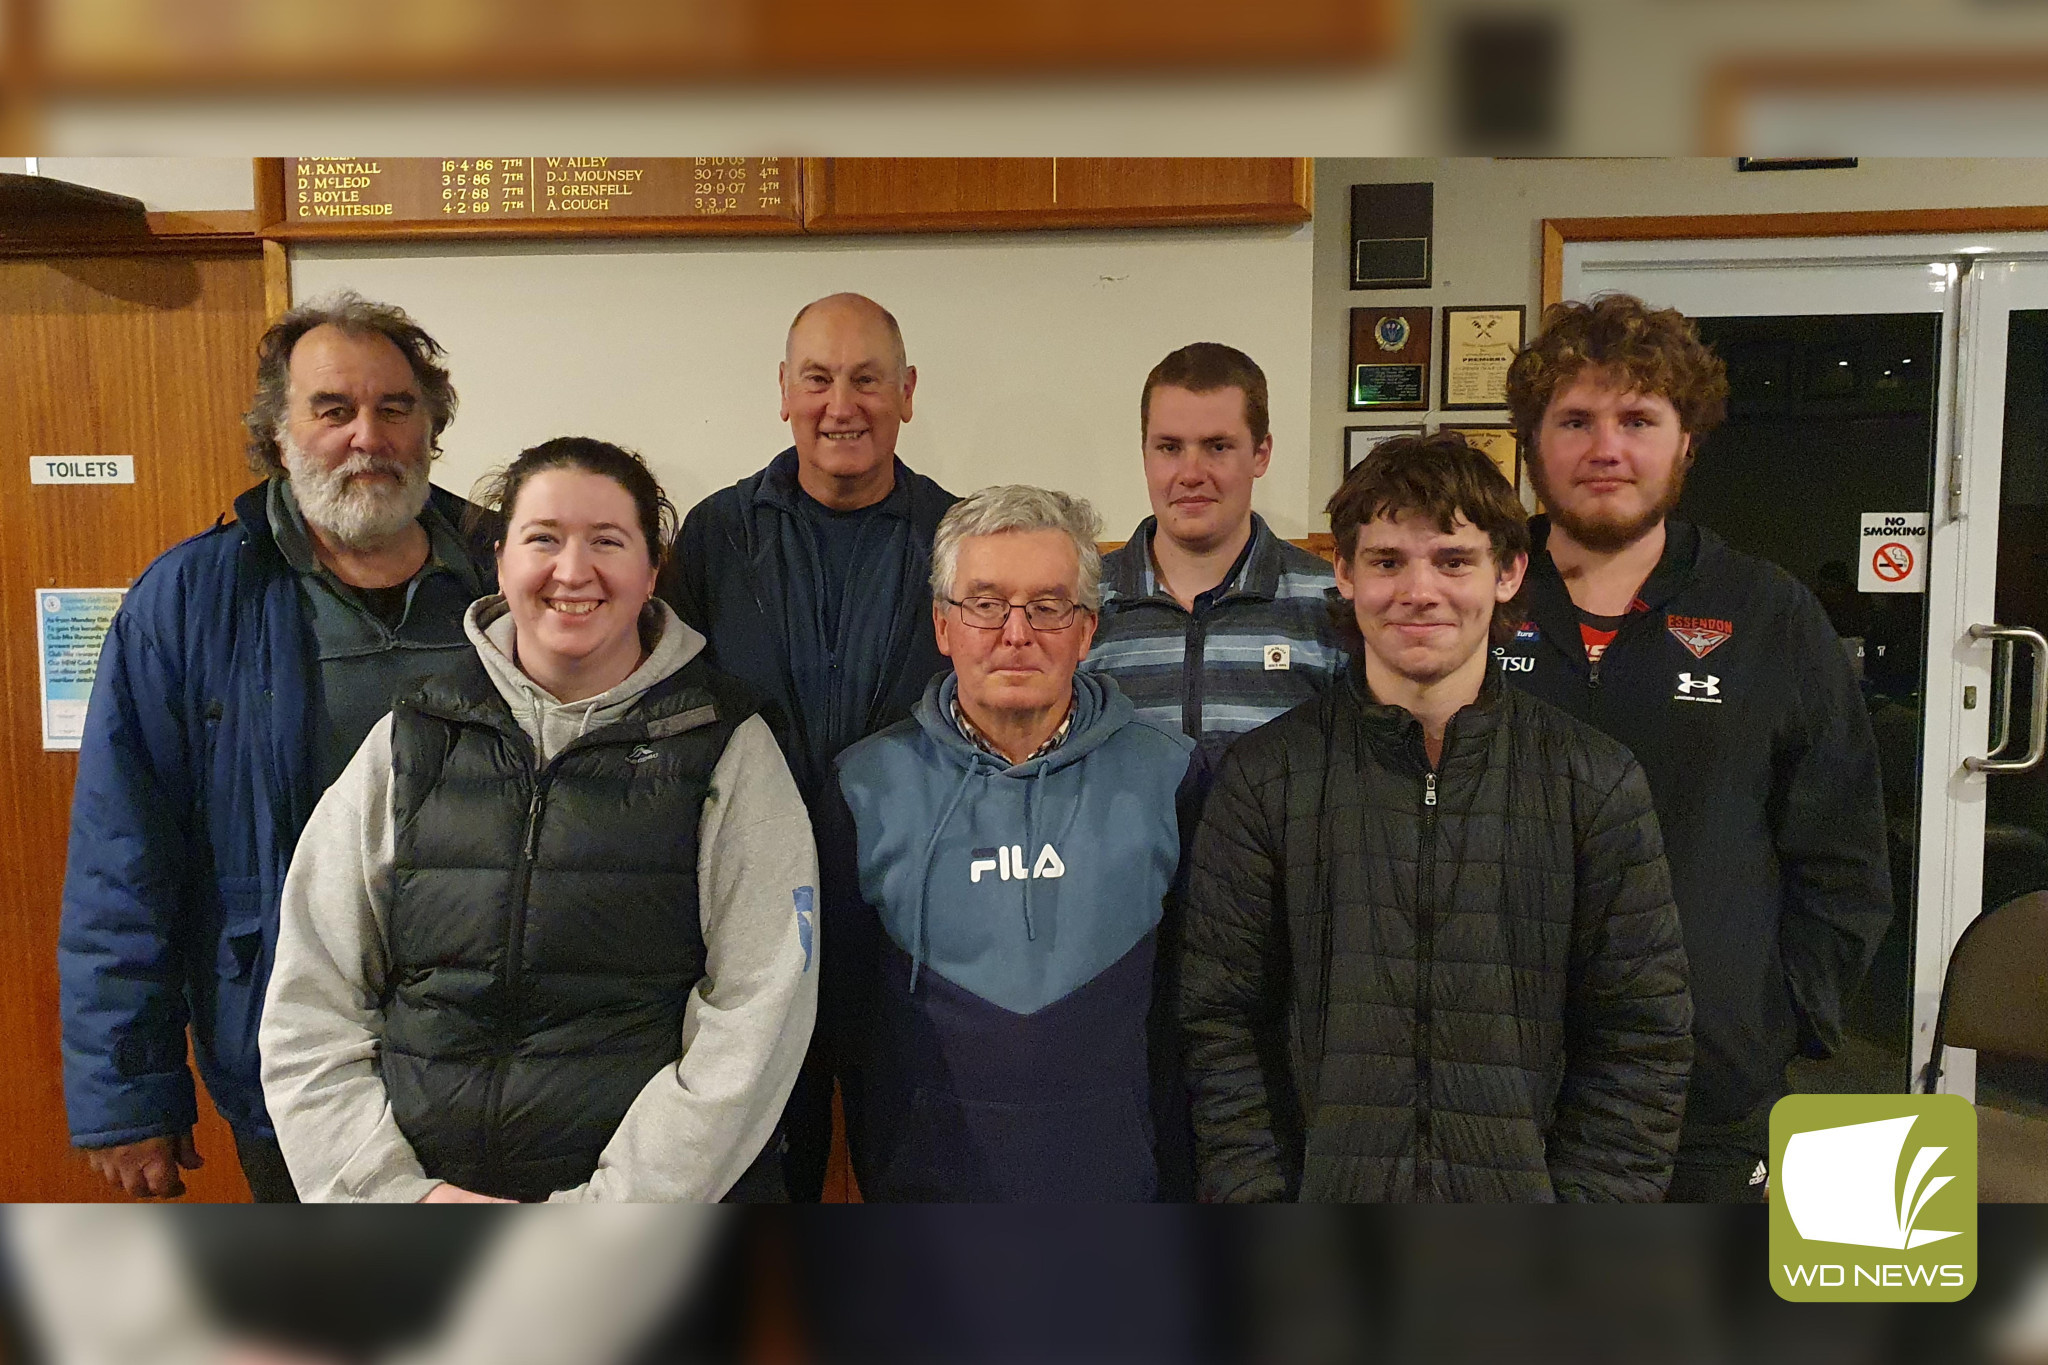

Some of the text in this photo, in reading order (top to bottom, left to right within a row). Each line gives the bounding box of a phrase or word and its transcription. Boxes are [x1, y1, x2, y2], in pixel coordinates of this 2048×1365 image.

[502, 159, 523, 171] 7TH
[567, 157, 608, 168] AILEY
[316, 163, 382, 175] RANTALL
[759, 168, 779, 179] 4TH
[502, 173, 524, 185] 7TH
[574, 170, 643, 181] MOUNSEY
[502, 187, 524, 199] 7TH
[562, 184, 633, 196] GRENFELL
[759, 182, 779, 193] 4TH
[314, 191, 360, 203] BOYLE
[759, 197, 781, 208] 7TH
[314, 204, 393, 217] WHITESIDE
[502, 201, 524, 212] 7TH
[561, 199, 609, 210] COUCH
[46, 462, 118, 477] TOILETS
[1885, 517, 1906, 526] NO
[1863, 527, 1926, 536] SMOKING
[1667, 615, 1733, 635] ESSENDON
[970, 843, 1066, 883] FILA
